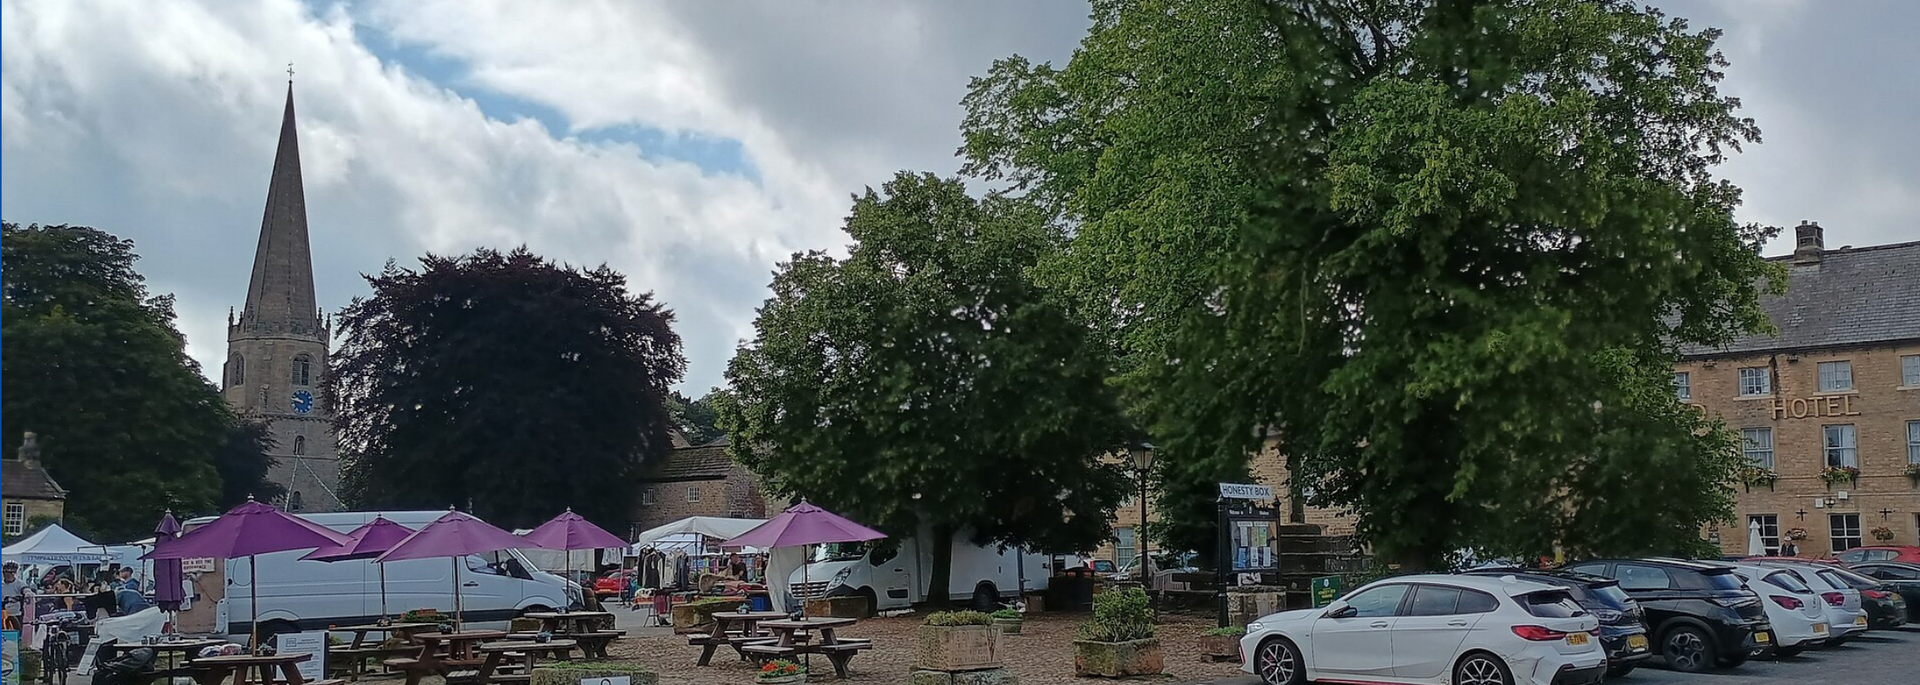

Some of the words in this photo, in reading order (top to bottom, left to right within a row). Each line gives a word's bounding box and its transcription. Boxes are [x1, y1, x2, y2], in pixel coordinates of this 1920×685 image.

[1771, 395, 1861, 420] HOTEL
[1222, 485, 1253, 496] HONESTY
[1254, 487, 1270, 496] BOX
